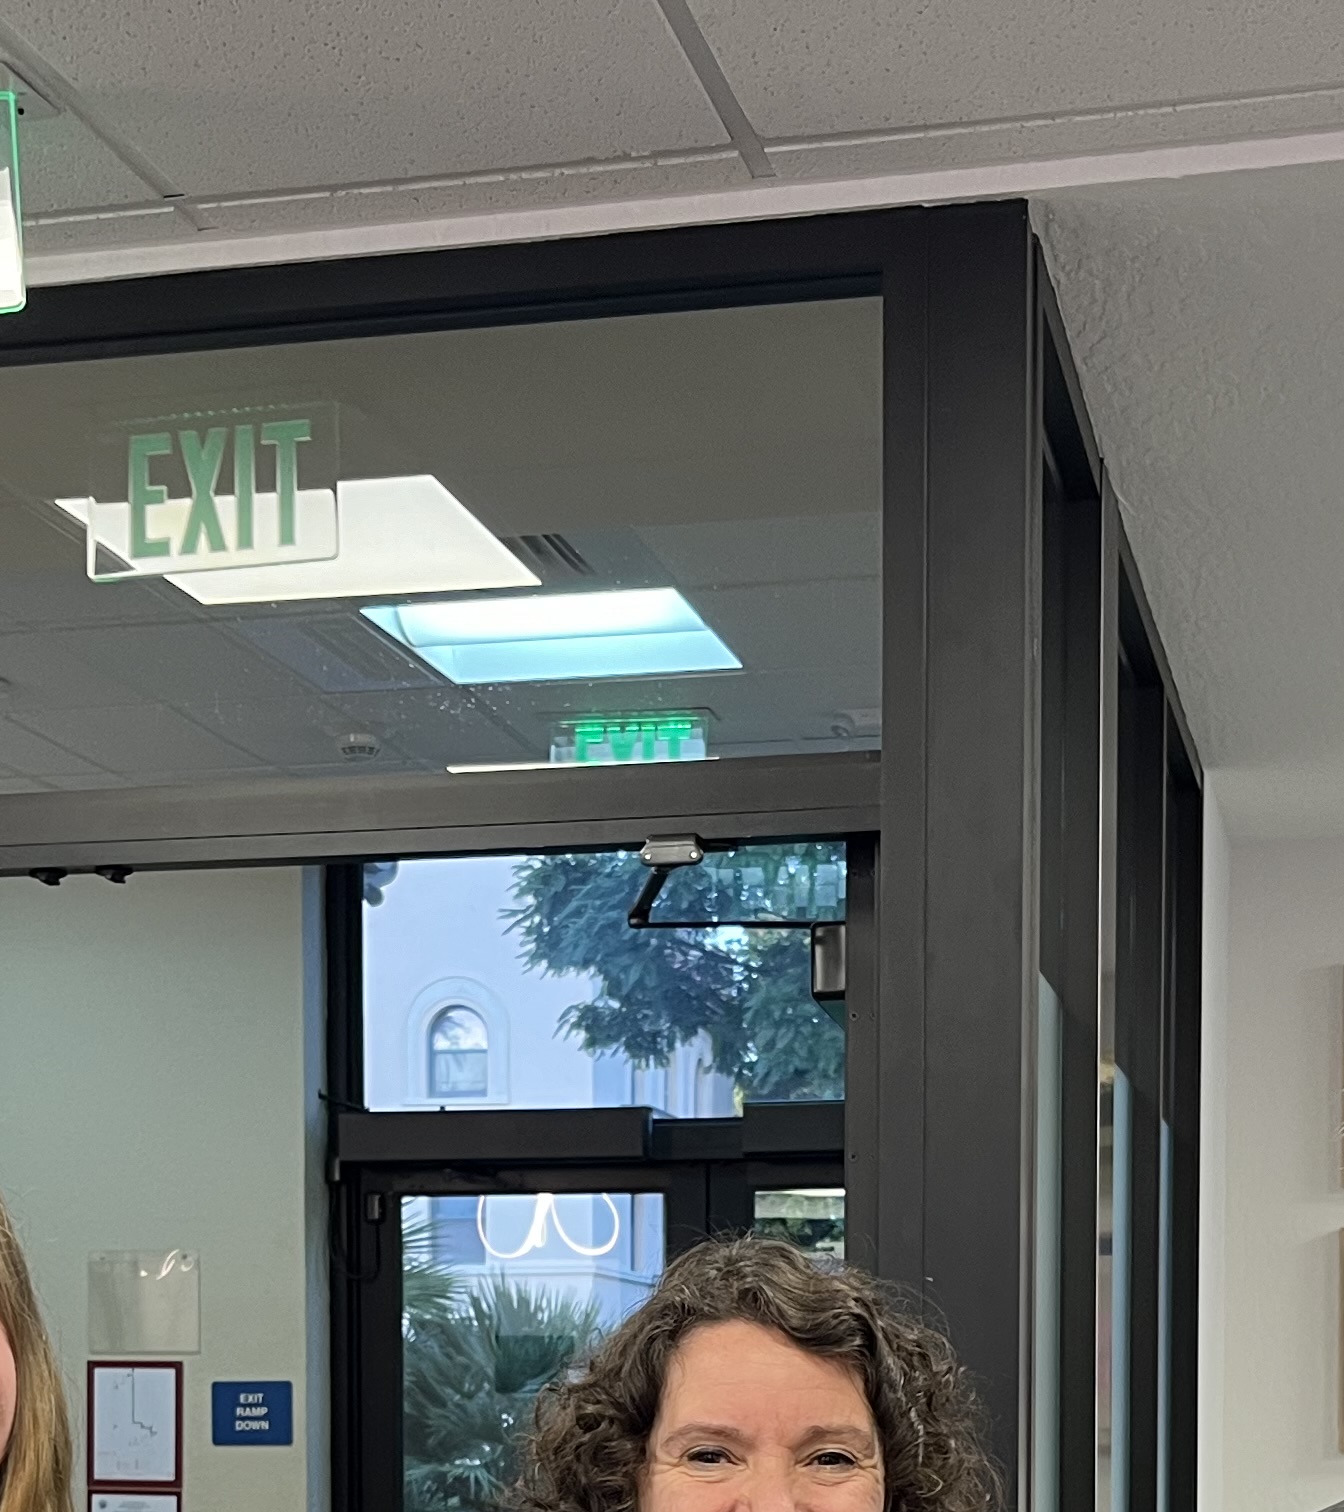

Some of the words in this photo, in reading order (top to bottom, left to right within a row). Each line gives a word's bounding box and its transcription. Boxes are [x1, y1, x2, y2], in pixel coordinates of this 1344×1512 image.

[128, 418, 311, 560] EXIT
[239, 1392, 264, 1404] EXIT
[236, 1406, 268, 1417] RAMP
[235, 1420, 269, 1431] DOWN
